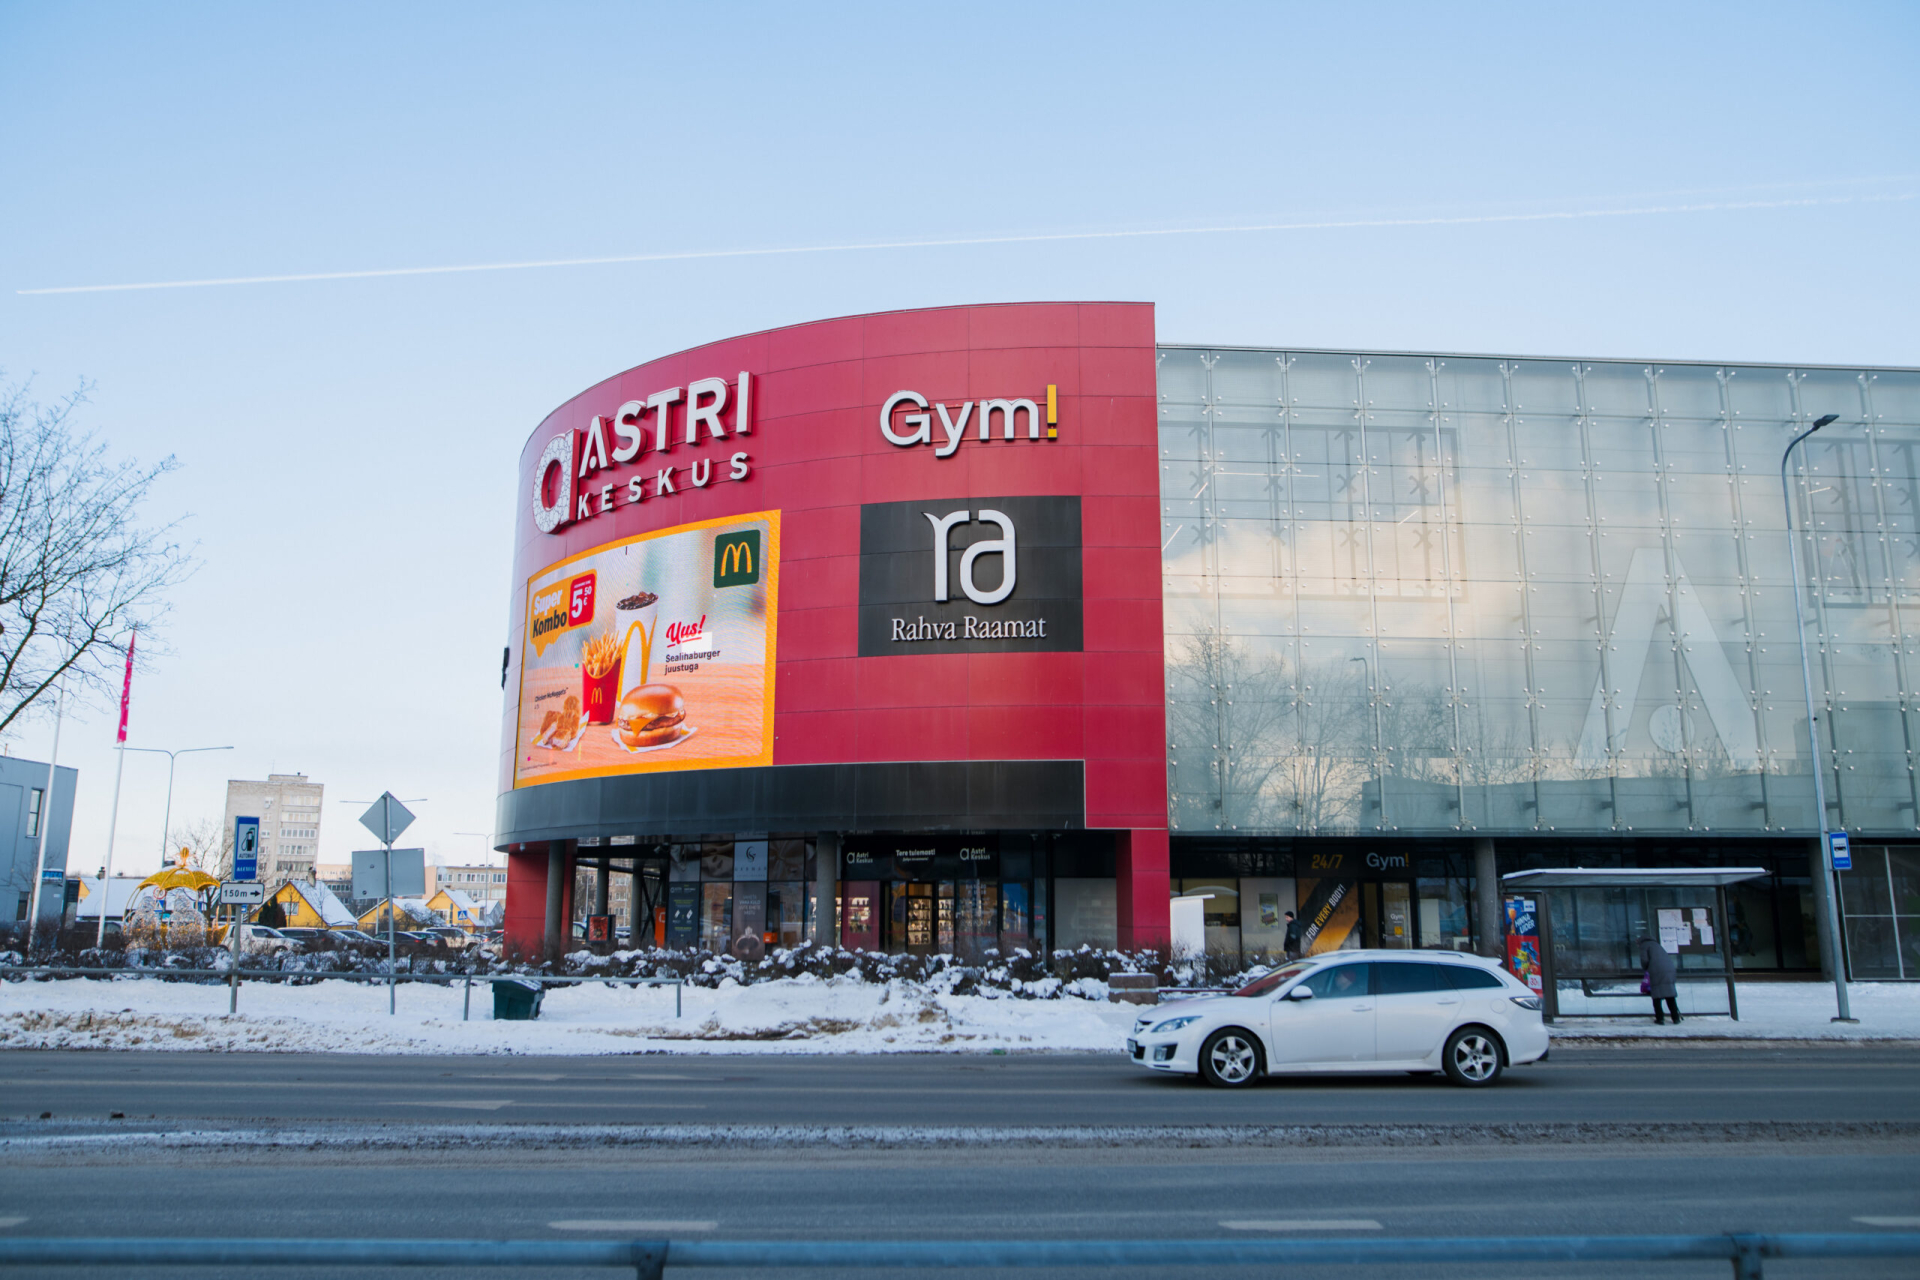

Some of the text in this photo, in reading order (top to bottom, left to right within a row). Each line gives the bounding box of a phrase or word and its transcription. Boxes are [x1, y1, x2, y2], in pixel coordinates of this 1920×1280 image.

[579, 371, 754, 478] ASTRI
[880, 384, 1057, 458] Gym!
[577, 451, 752, 521] KESKUS
[921, 509, 1016, 605] ra
[534, 589, 563, 616] Super
[571, 588, 583, 619] 5
[533, 609, 567, 638] Kombo
[666, 614, 706, 645] Uus!
[891, 616, 1047, 641] Rahva Raamat
[664, 663, 699, 676] juustuga
[1311, 854, 1344, 869] 24/7
[1366, 852, 1409, 870] Gym!
[224, 889, 248, 898] 150m
[1305, 883, 1347, 940] FOR EVERY BODY!
